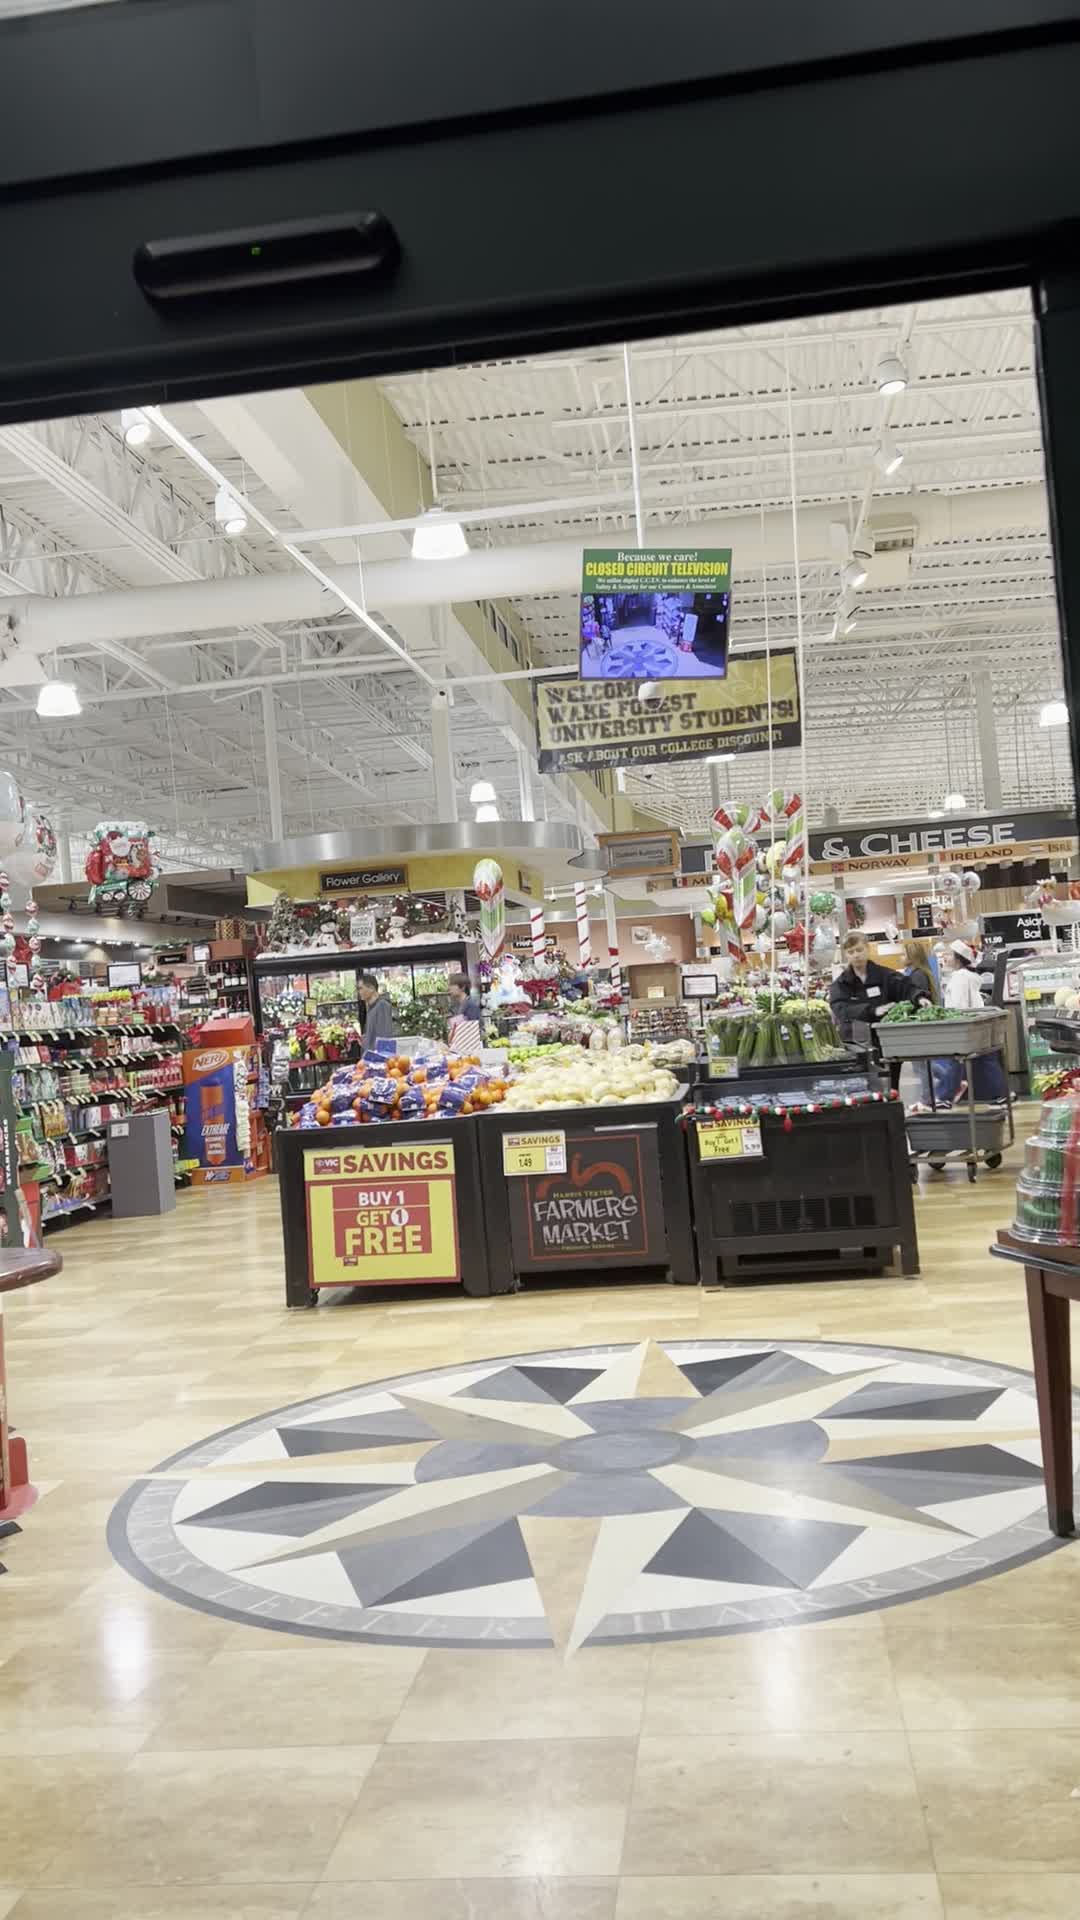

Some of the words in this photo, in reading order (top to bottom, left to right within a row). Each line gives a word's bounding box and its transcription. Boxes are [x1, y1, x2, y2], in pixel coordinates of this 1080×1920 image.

[617, 552, 656, 562] Because
[658, 554, 672, 562] we
[673, 552, 697, 562] care!
[585, 561, 625, 576] CLOSED
[627, 561, 669, 576] CIRCUIT
[671, 561, 729, 576] TELEVISION
[547, 703, 612, 725] WAKE
[548, 716, 673, 744] UNIVERSITY
[680, 698, 794, 731] STUDENTS!
[586, 747, 629, 764] ABOUT
[631, 745, 658, 758] OUR
[661, 738, 714, 754] COLLEGE
[821, 836, 850, 861] &
[859, 822, 1017, 858] CHEESE
[848, 857, 910, 872] NORWAY
[950, 847, 1014, 863] IRELAND
[326, 876, 361, 887] Flower
[362, 872, 400, 884] Gallery
[521, 1135, 560, 1145] SAVINGS
[3, 1118, 12, 1185] STARBUCKS
[343, 1150, 449, 1174] SAVINGS
[358, 1191, 392, 1206] BUY
[396, 1190, 405, 1205] 1
[533, 1195, 638, 1222] FARMERS
[356, 1210, 390, 1226] GET
[345, 1225, 423, 1256] FREE
[542, 1220, 632, 1245] MARKET
